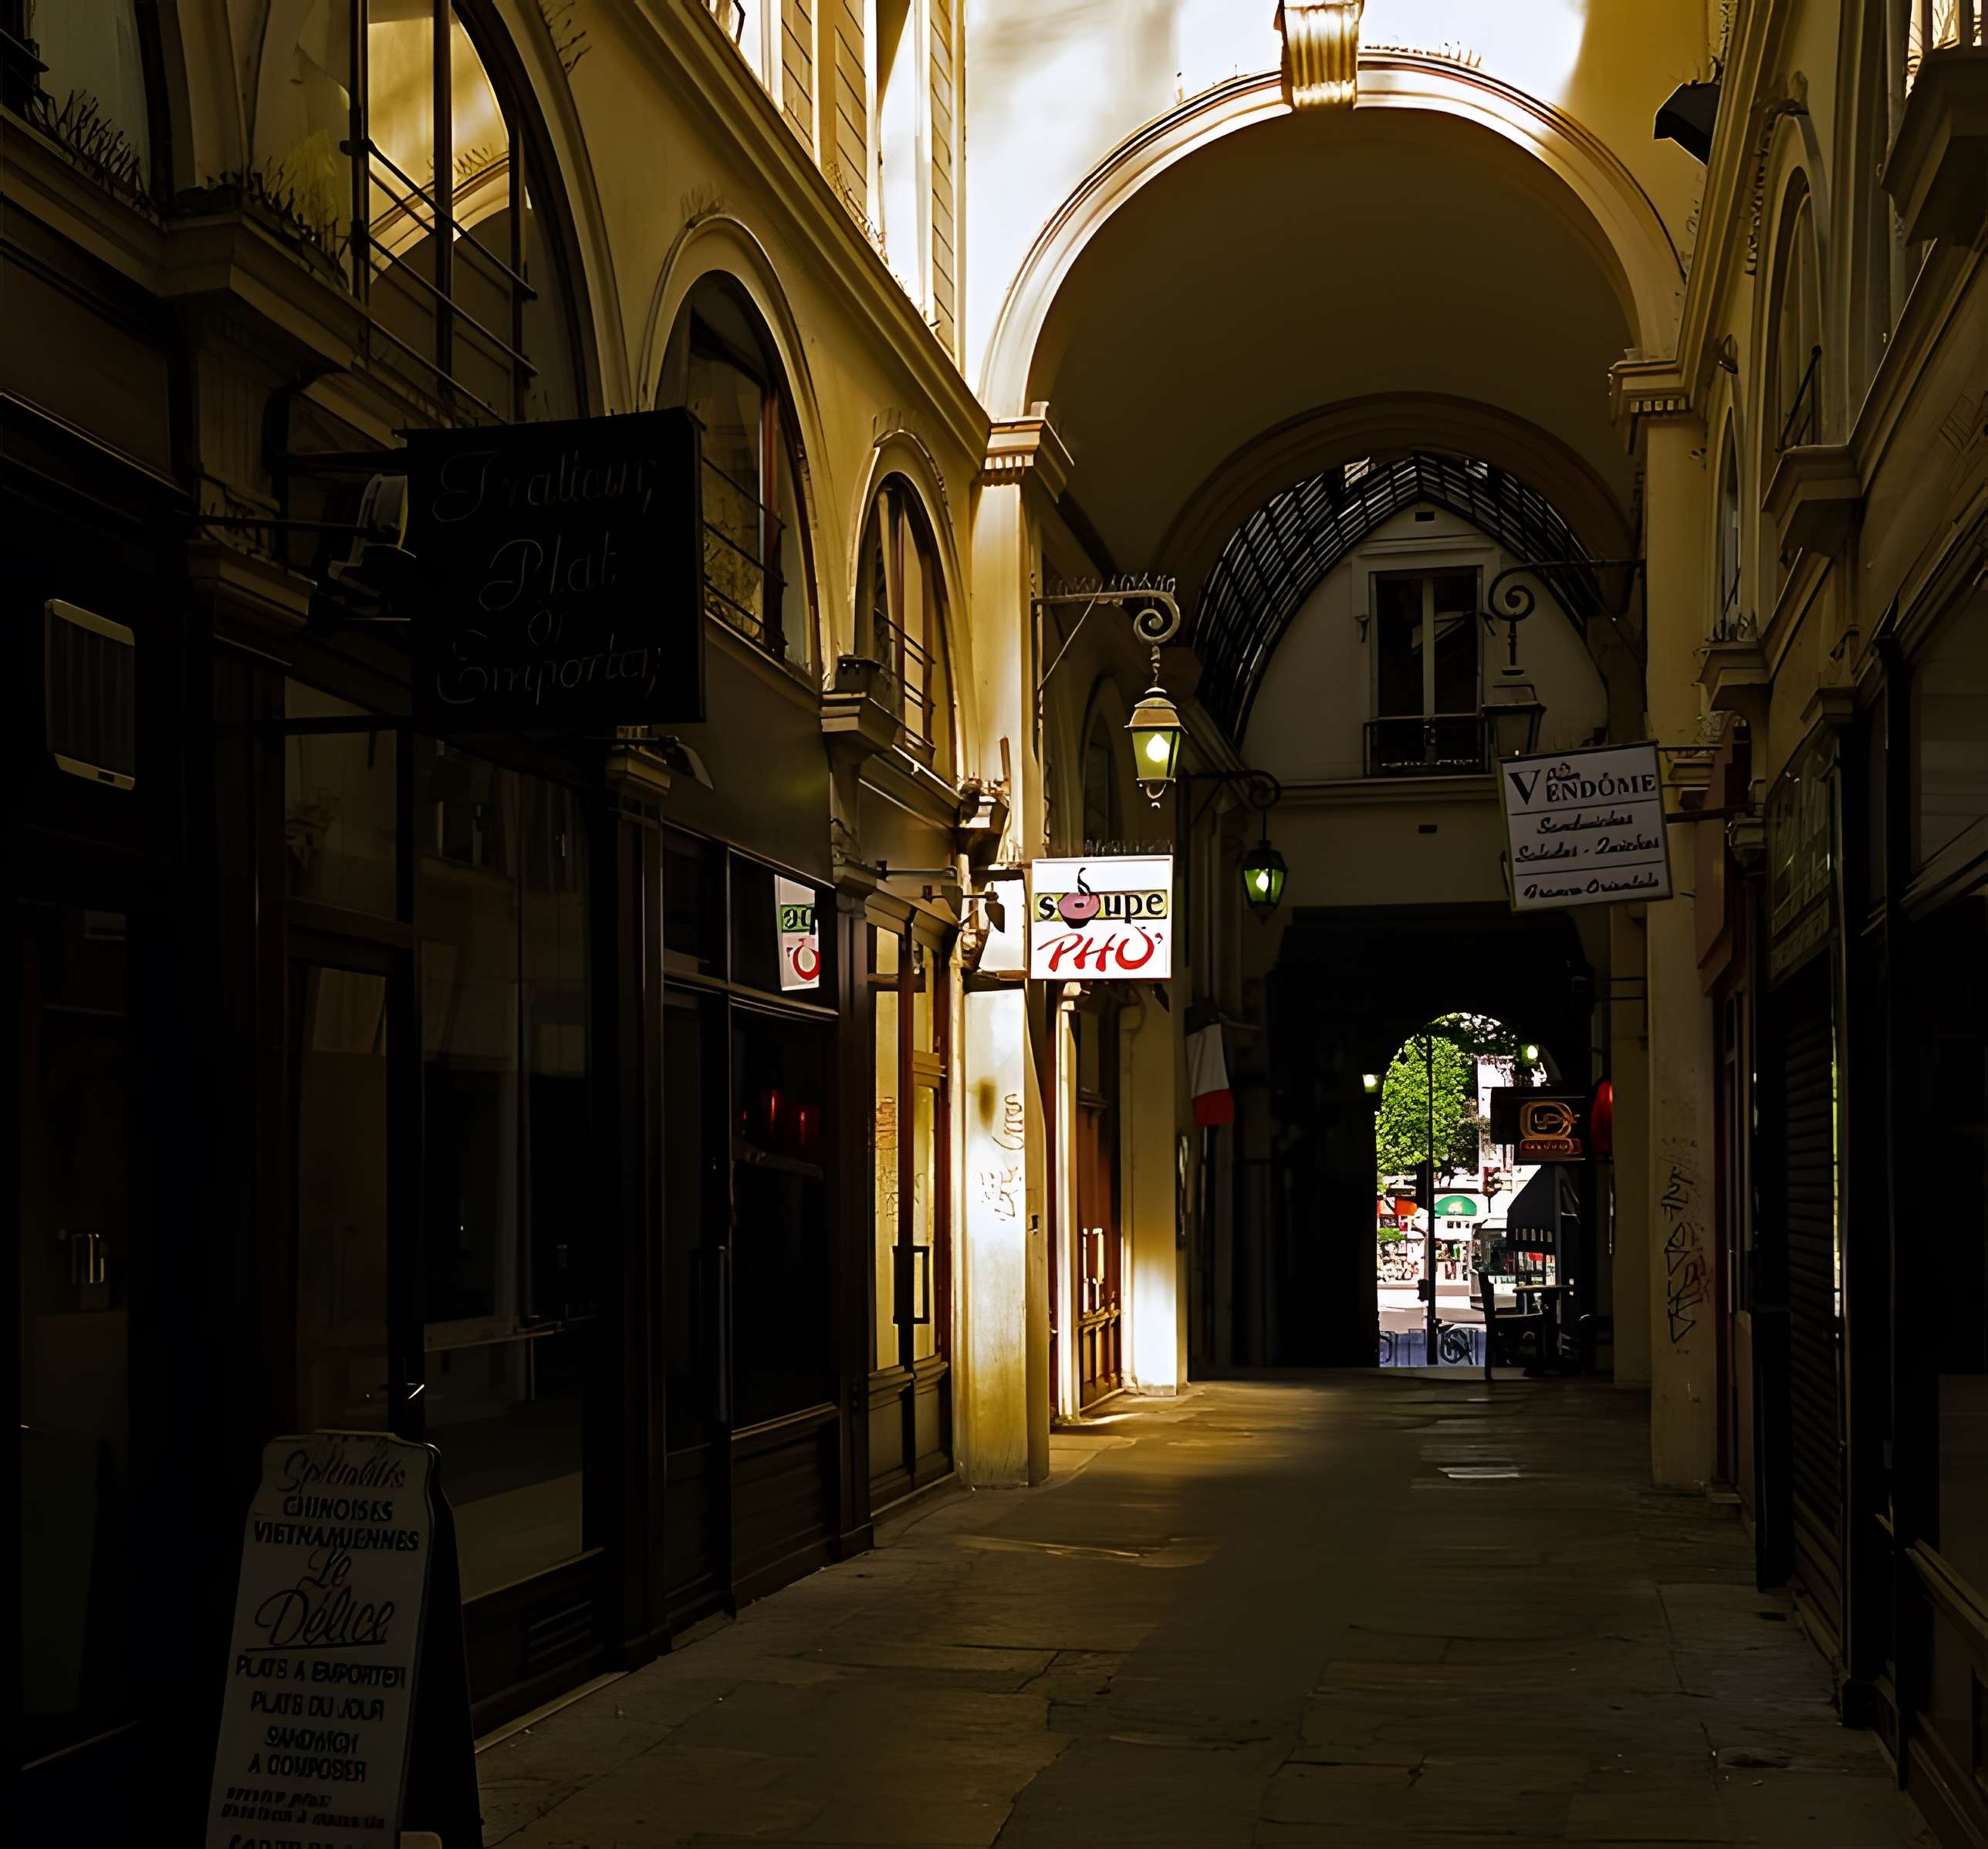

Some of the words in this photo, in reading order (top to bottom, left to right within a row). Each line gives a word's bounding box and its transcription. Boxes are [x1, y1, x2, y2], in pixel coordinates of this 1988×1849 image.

[235, 1655, 288, 1678] PLATS
[250, 1691, 303, 1715] PLATS
[308, 1695, 334, 1717] DU
